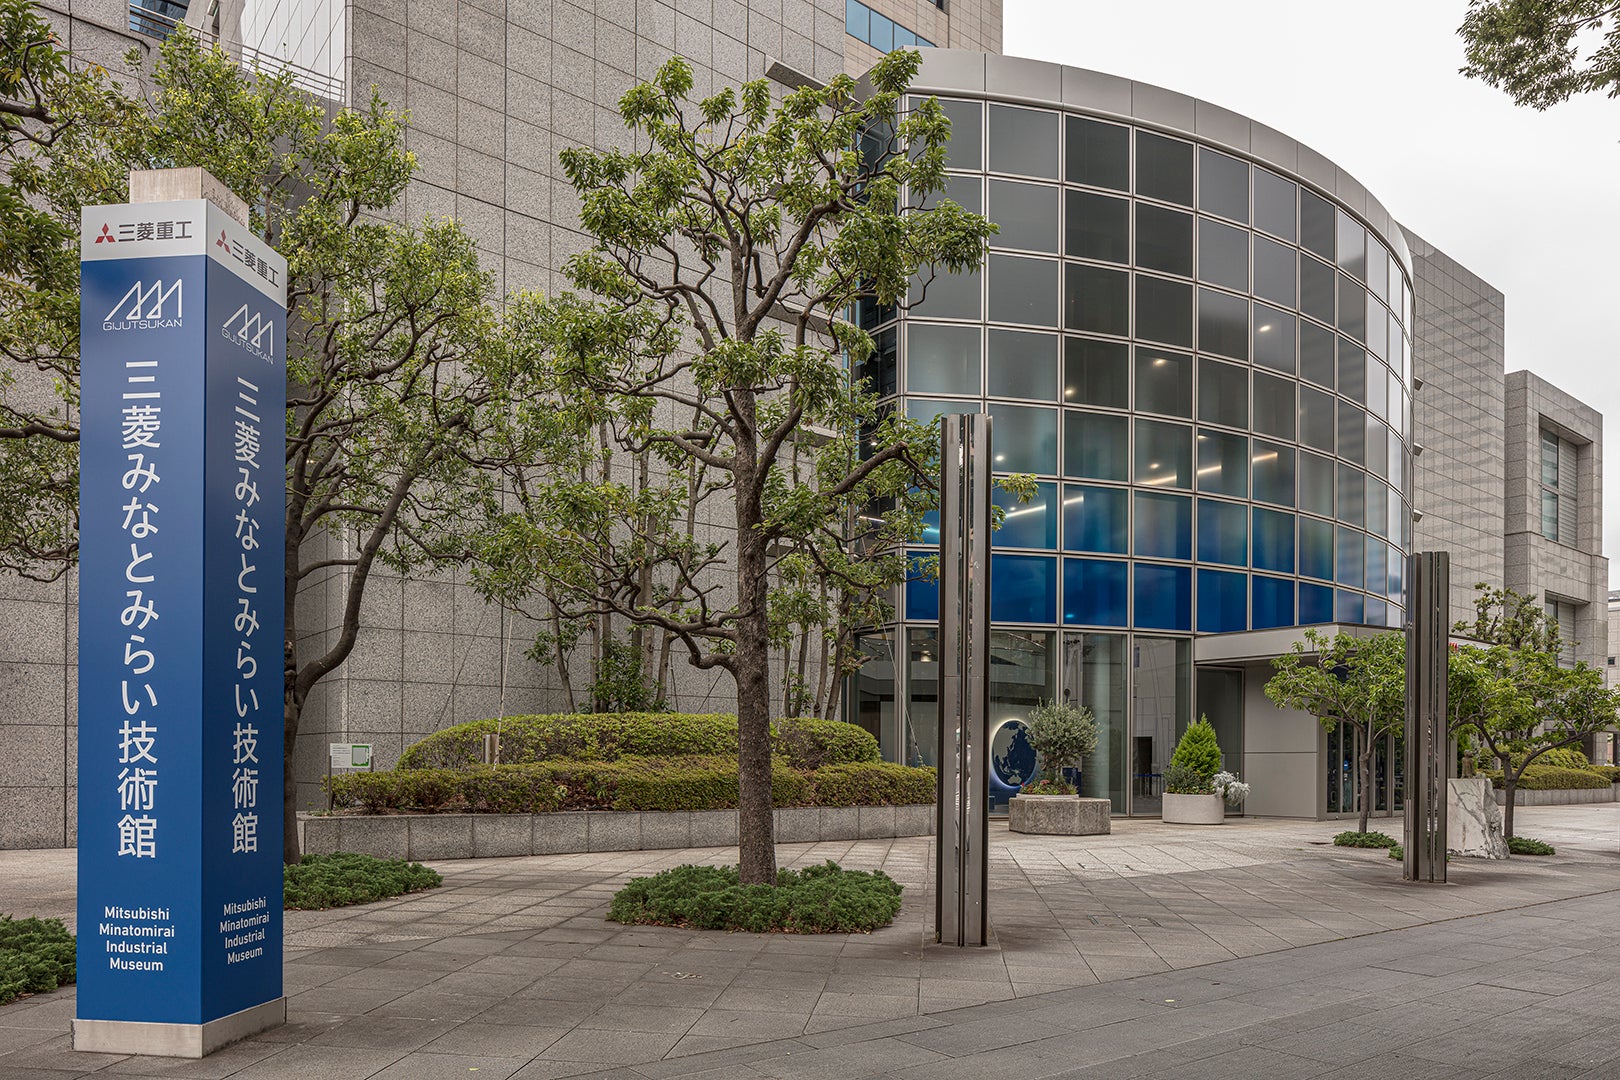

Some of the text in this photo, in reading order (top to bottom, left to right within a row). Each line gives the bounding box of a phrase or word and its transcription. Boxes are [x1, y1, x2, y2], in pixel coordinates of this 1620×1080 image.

[118, 221, 193, 242] 三菱重工
[232, 239, 279, 288] 三菱重工
[102, 318, 183, 331] GIJUTSUKAN
[221, 328, 274, 364] GIJUTSUKAN
[117, 360, 161, 859] 三菱みなとみらい技術館
[232, 376, 261, 854] 三菱みなとみらい技術館
[104, 906, 170, 920] Mitsubishi
[223, 896, 267, 916] Mitsubishi
[99, 923, 175, 938] Minatomirai
[219, 911, 270, 933] Minatomirai
[106, 940, 168, 954] Industrial
[224, 928, 265, 949] Industrial
[109, 957, 164, 971] Museum
[227, 947, 263, 964] Museum
